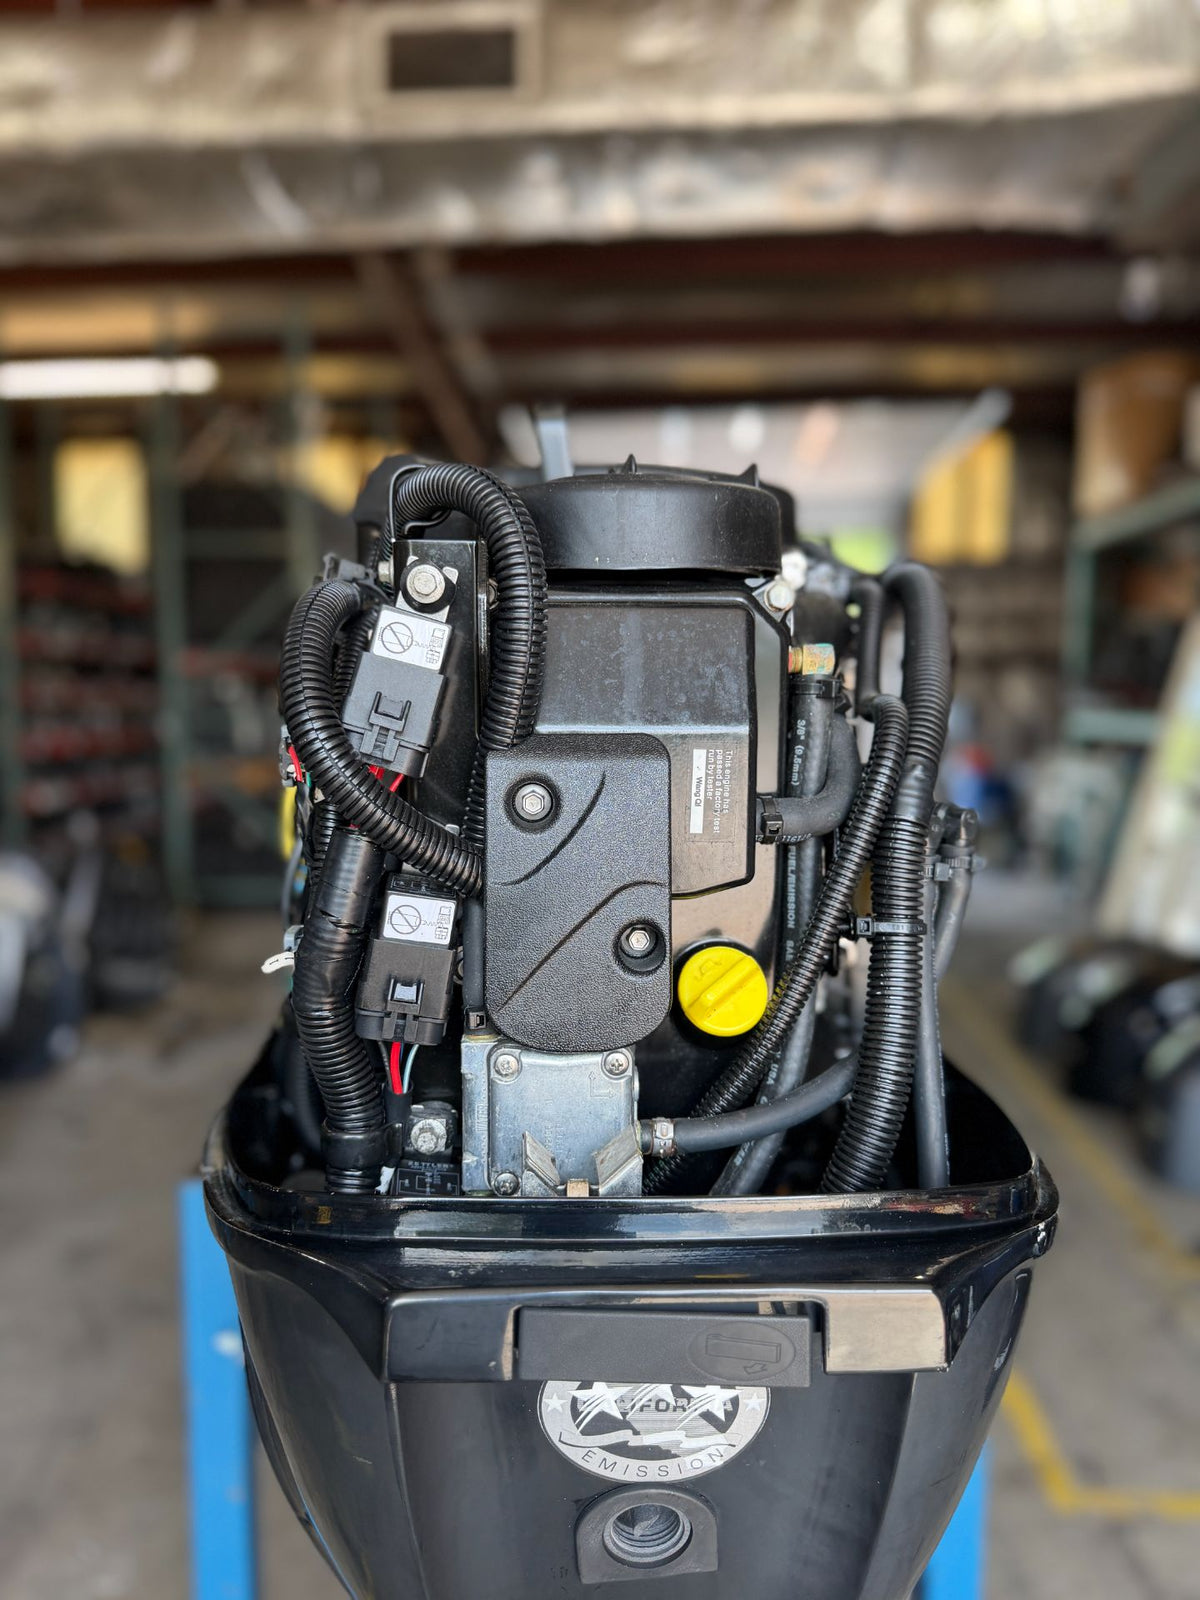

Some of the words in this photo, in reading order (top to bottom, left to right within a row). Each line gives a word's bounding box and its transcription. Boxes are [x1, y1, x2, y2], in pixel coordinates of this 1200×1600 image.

[796, 719, 806, 740] 3/8"
[706, 765, 715, 775] by
[715, 749, 723, 779] passed
[725, 750, 733, 768] This
[791, 745, 805, 786] (9.5mm)
[694, 777, 703, 797] Wang
[706, 776, 714, 800] tester
[723, 769, 731, 797] engine
[713, 788, 722, 815] factory
[787, 845, 796, 929] FUEL/EMISSION
[765, 1063, 779, 1085] USA
[581, 1448, 724, 1478] EMISSION
